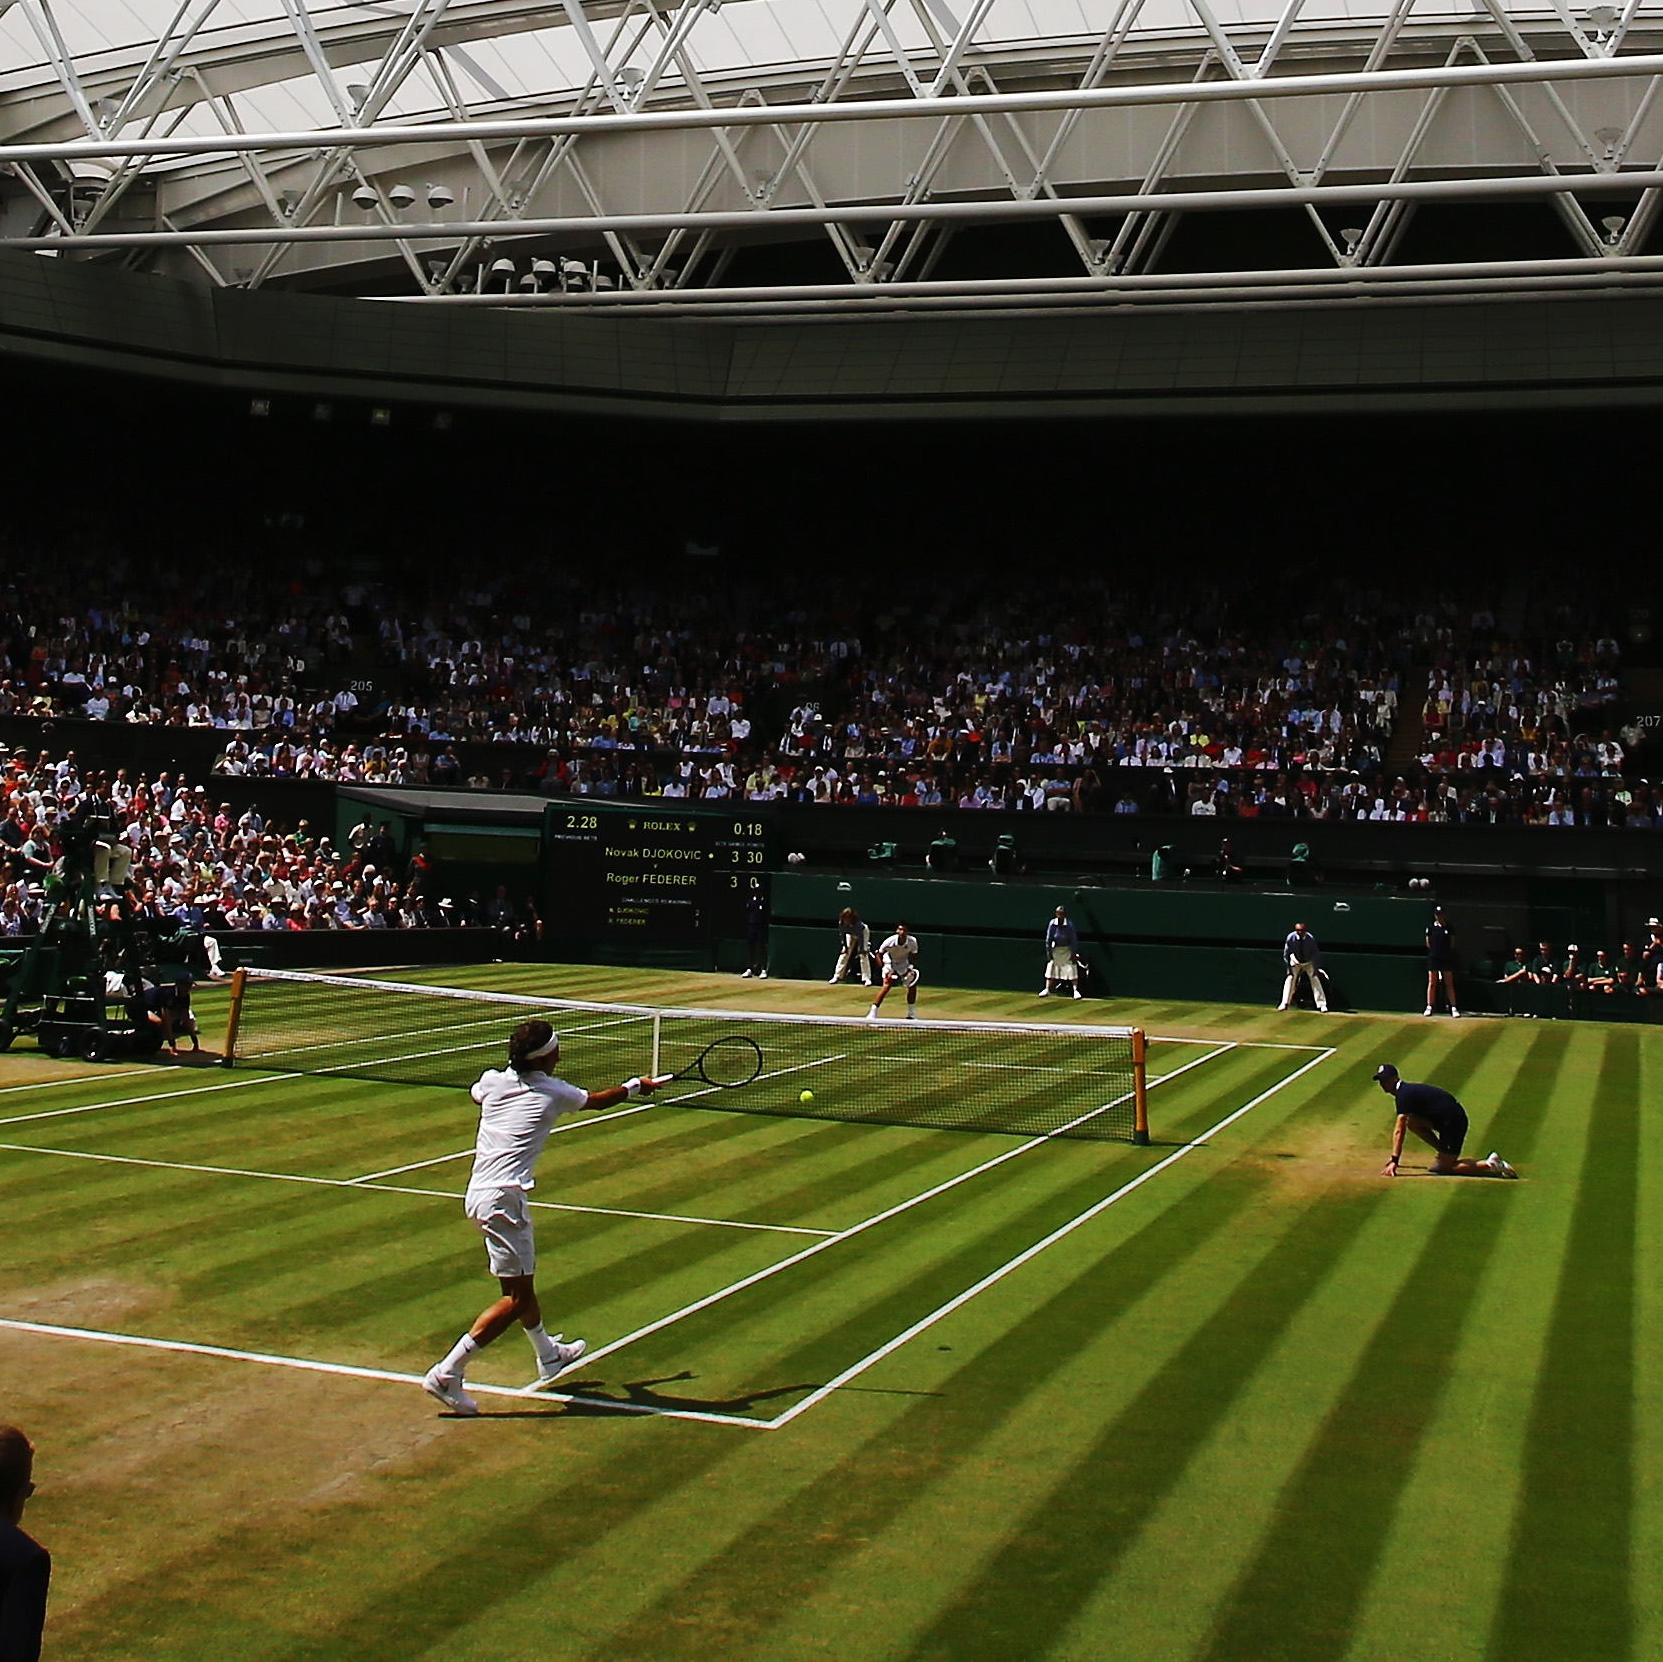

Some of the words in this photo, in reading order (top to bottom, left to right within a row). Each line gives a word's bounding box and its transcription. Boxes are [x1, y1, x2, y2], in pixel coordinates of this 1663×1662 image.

[350, 680, 373, 692] 205
[1636, 715, 1661, 727] 207
[566, 815, 598, 829] 2.28
[643, 821, 681, 832] ROLEX
[733, 822, 763, 836] 0.18
[605, 846, 639, 857] Novak
[642, 848, 702, 860] DJOKOVIC
[731, 850, 740, 863] 3
[746, 851, 763, 864] 30
[606, 872, 640, 886] Roger
[642, 873, 697, 885] FEDERER
[730, 876, 738, 888] 3
